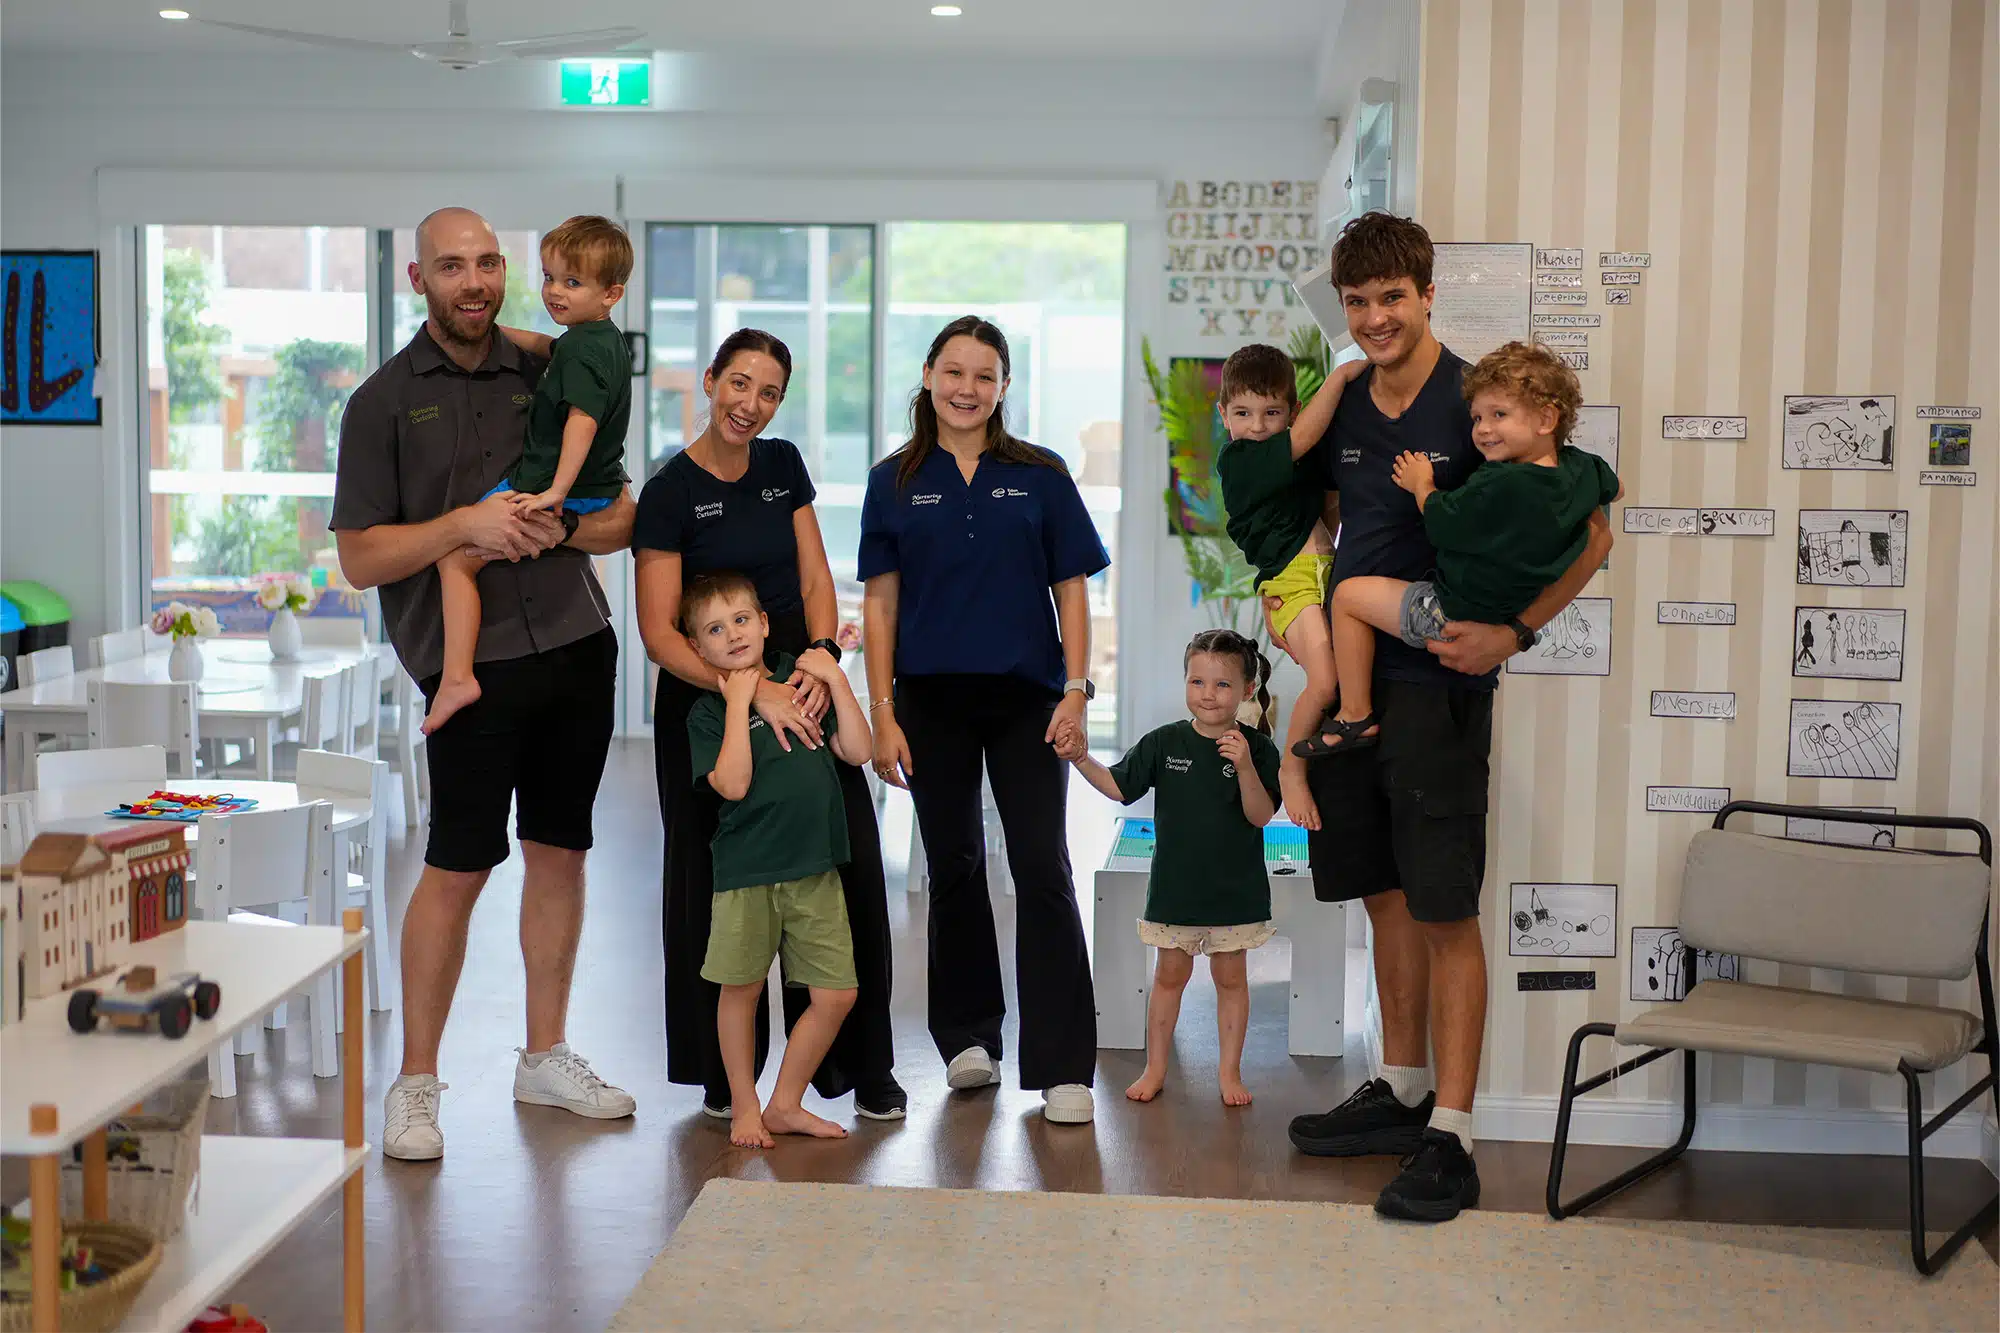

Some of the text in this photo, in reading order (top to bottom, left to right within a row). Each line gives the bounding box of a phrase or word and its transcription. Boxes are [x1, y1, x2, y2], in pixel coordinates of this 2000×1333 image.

[912, 493, 942, 501] Nurturing
[912, 498, 940, 506] Curiosity
[694, 501, 723, 513] Nurturing
[696, 509, 723, 519] Curiosity
[1166, 755, 1193, 767] Nurturing
[1165, 763, 1189, 773] Curiosity
